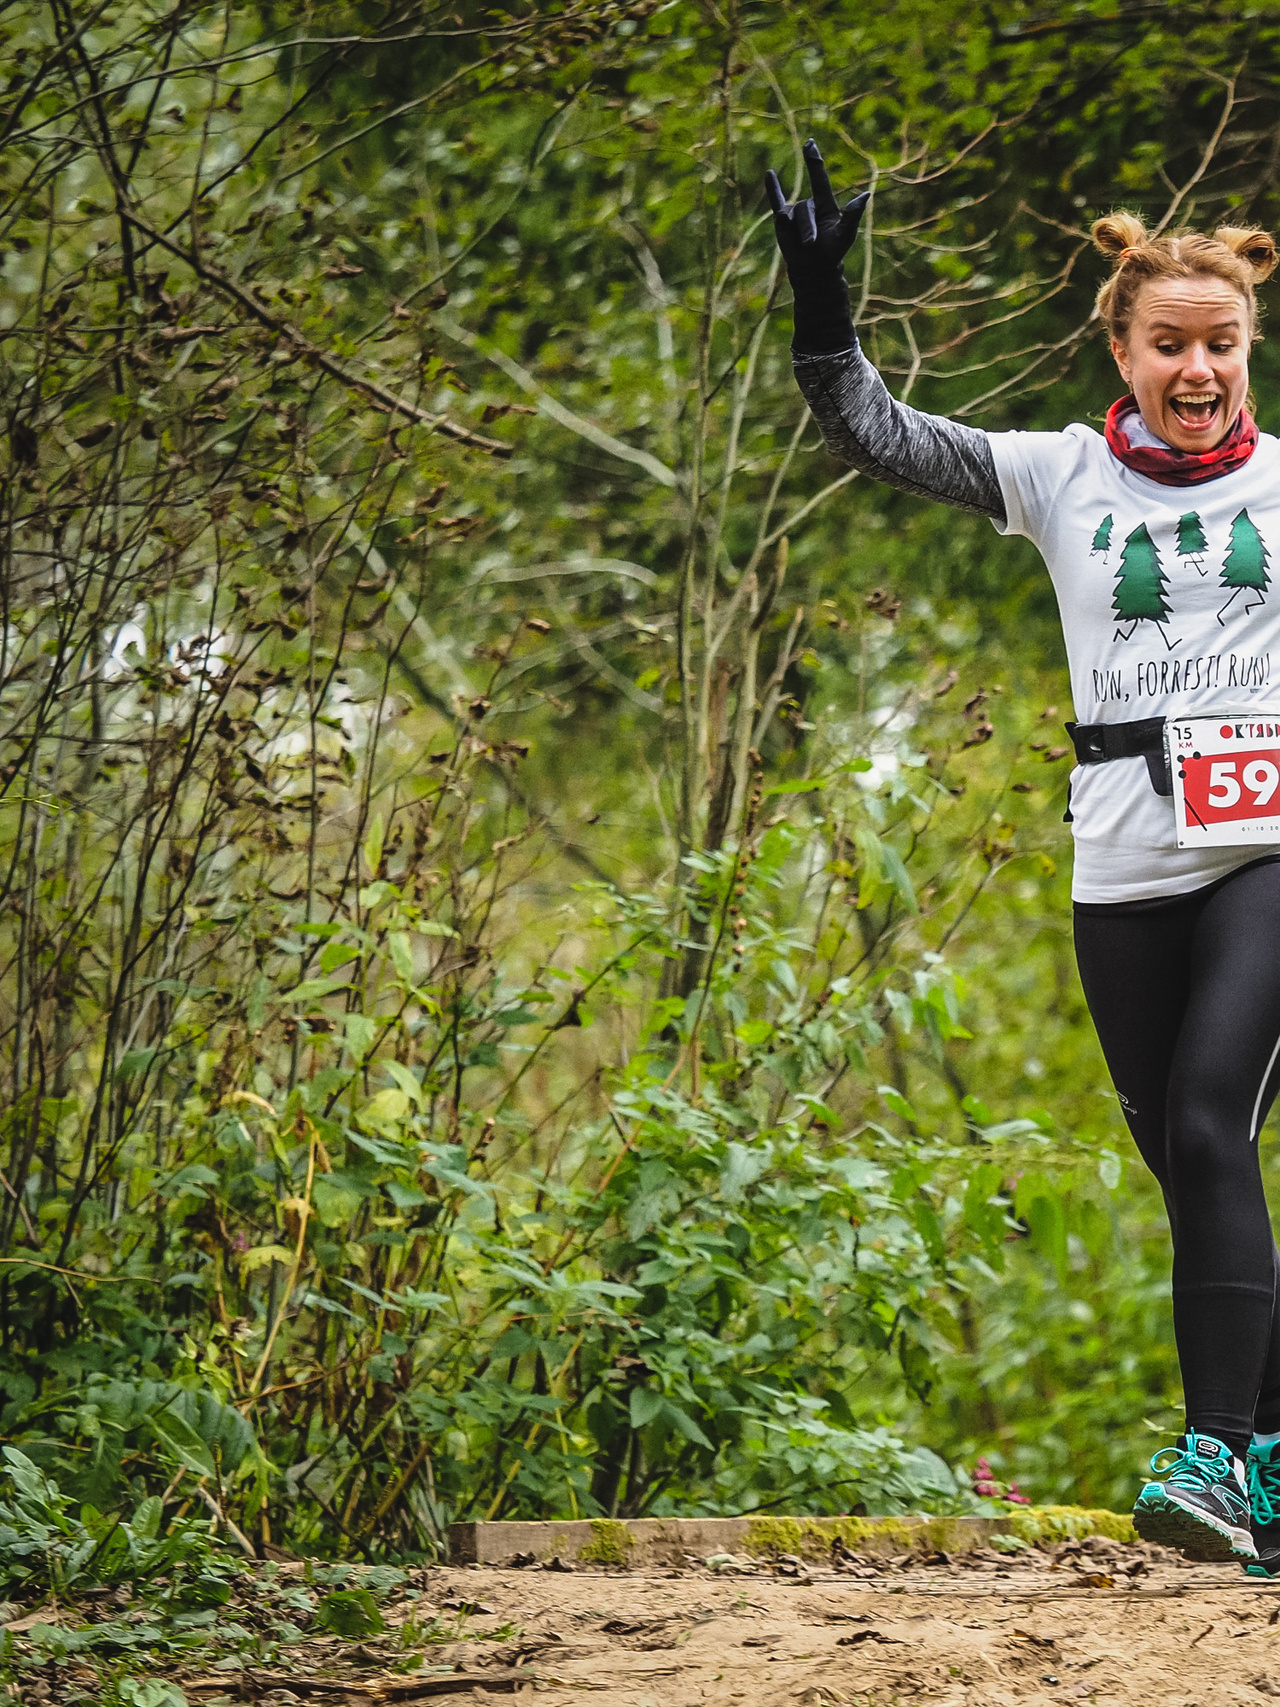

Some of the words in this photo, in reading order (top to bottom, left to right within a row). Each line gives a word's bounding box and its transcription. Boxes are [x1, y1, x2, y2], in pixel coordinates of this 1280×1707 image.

[1092, 669, 1130, 703] RUN,
[1137, 654, 1222, 697] FORREST!
[1228, 652, 1271, 687] RUN!
[1174, 727, 1193, 741] 15
